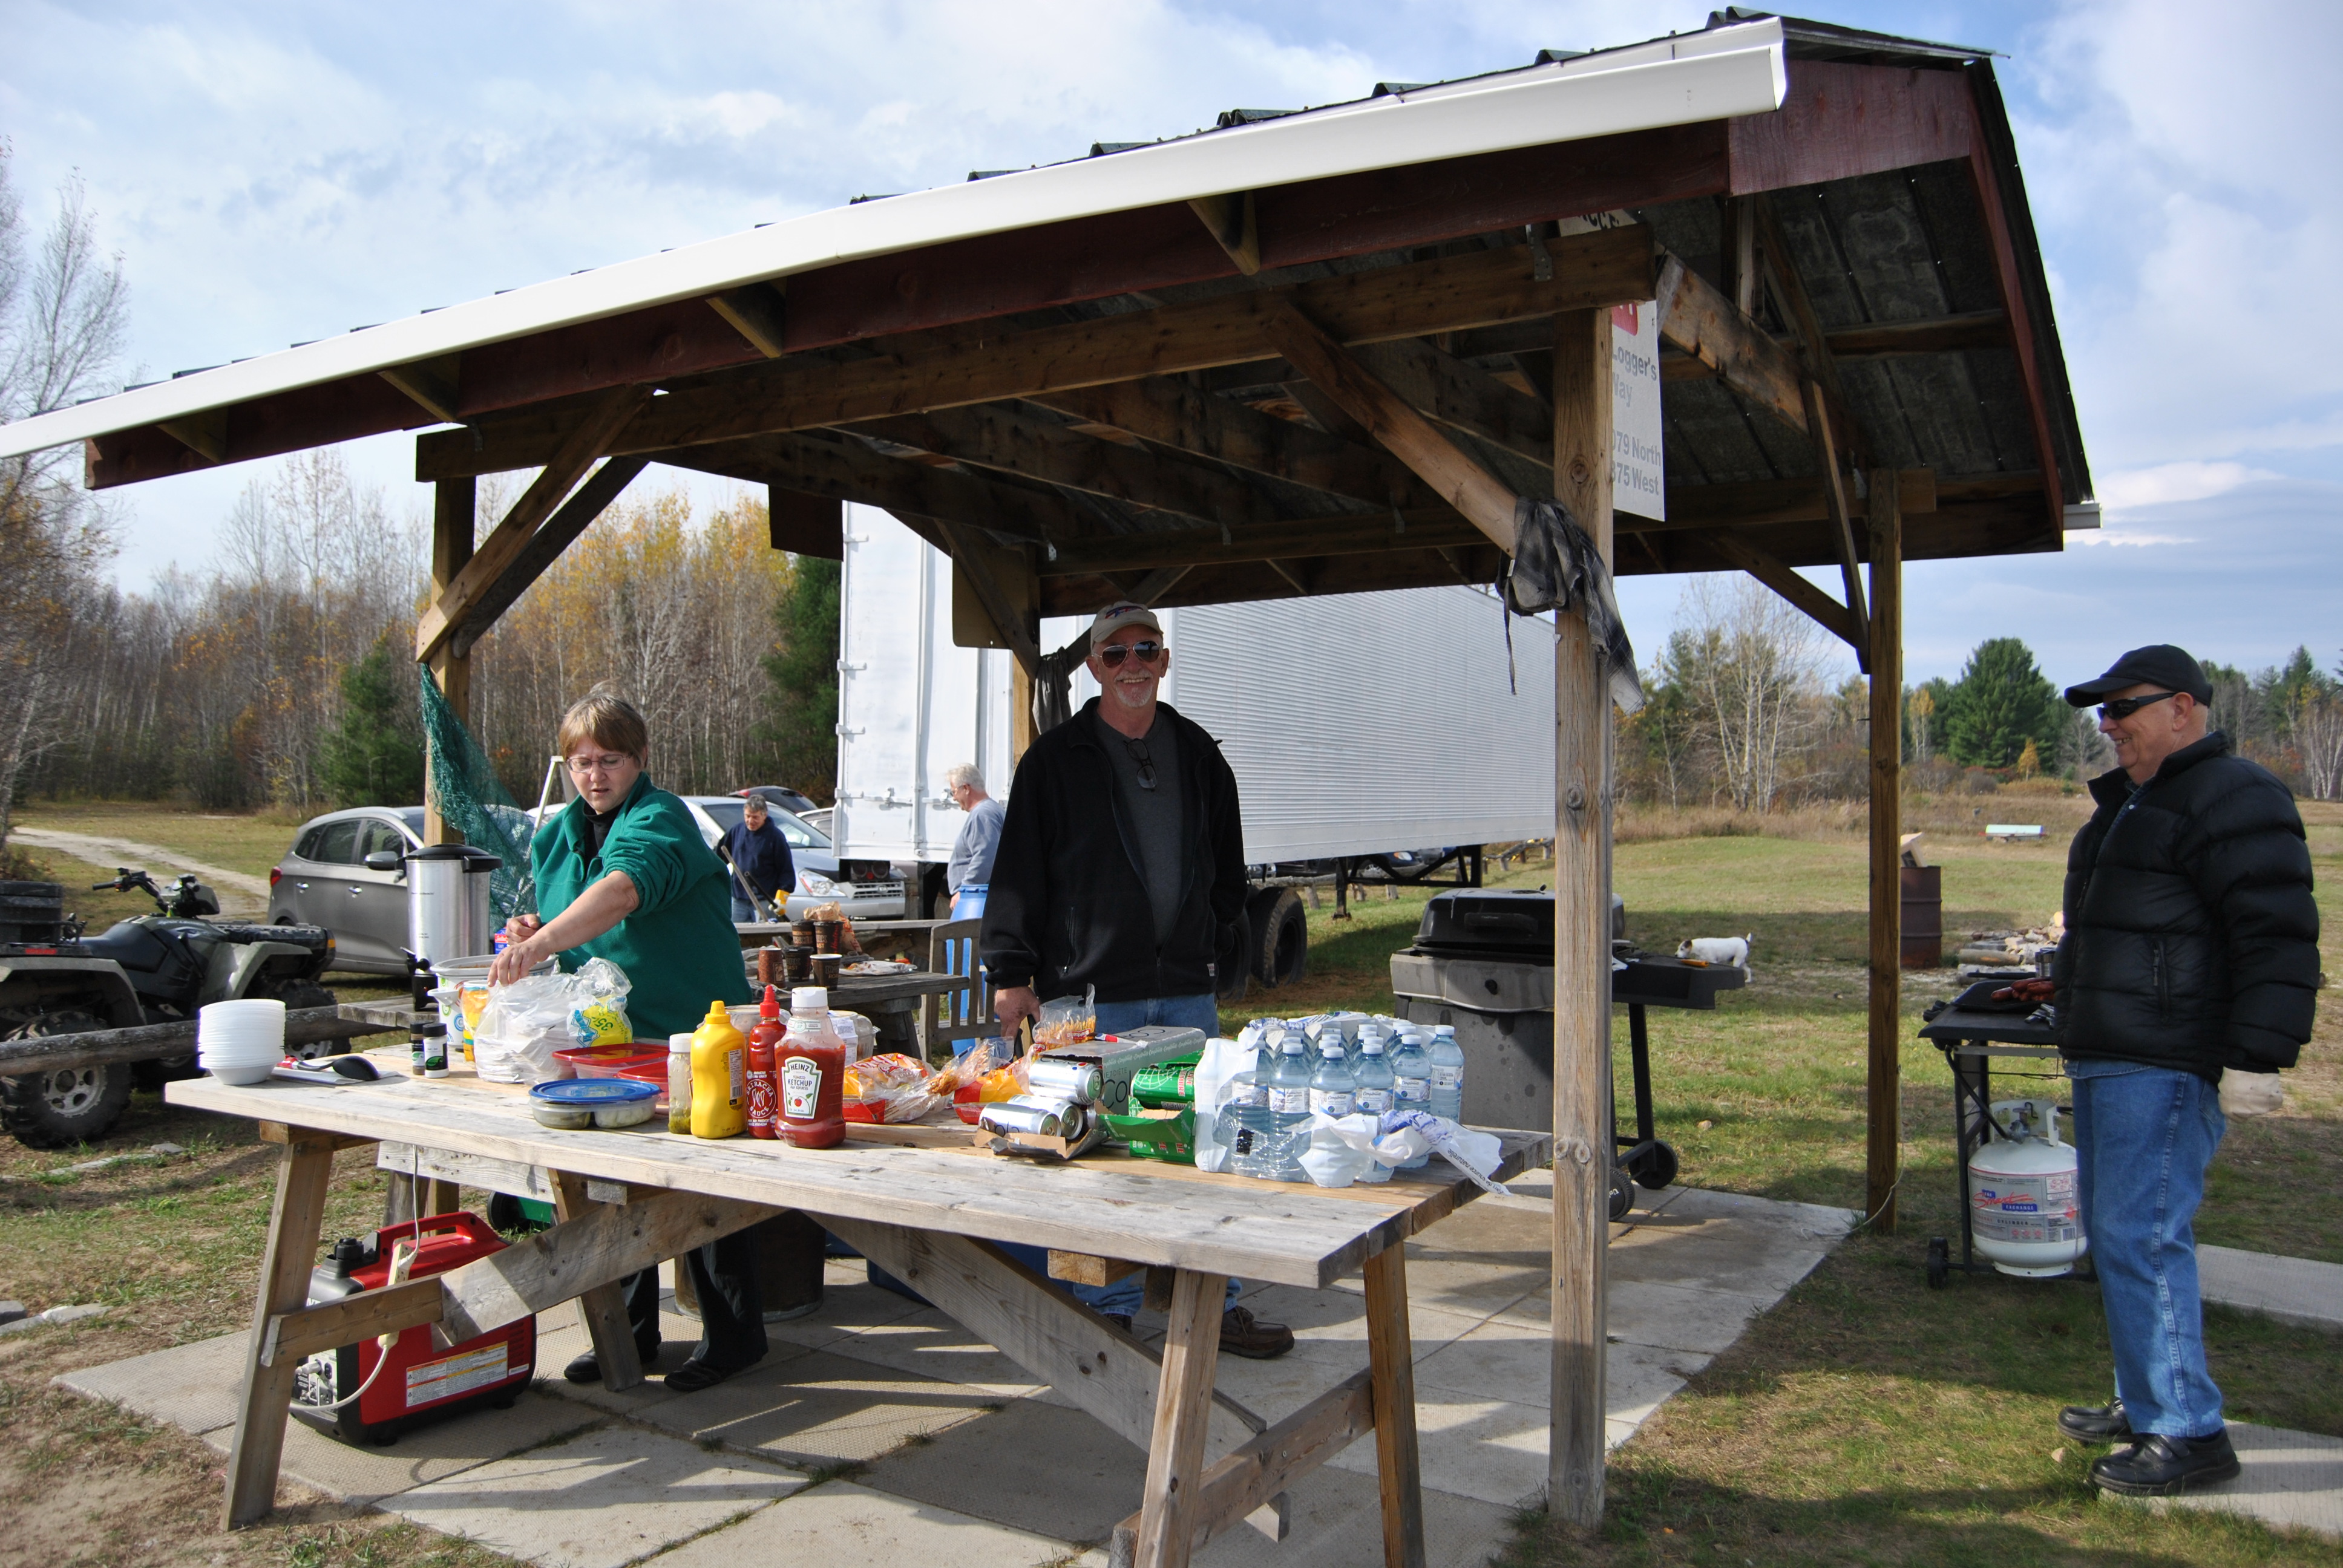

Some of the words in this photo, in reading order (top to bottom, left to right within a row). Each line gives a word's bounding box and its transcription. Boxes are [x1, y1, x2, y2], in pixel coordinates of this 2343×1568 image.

[1632, 437, 1661, 466] North
[1632, 467, 1659, 495] West
[790, 1063, 810, 1073] HEINZ
[746, 1082, 774, 1097] SRIRACHA
[750, 1106, 770, 1116] SAUCE
[1447, 1148, 1470, 1169] naturelle
[1469, 1166, 1486, 1181] source
[1973, 1192, 2034, 1209] Smart
